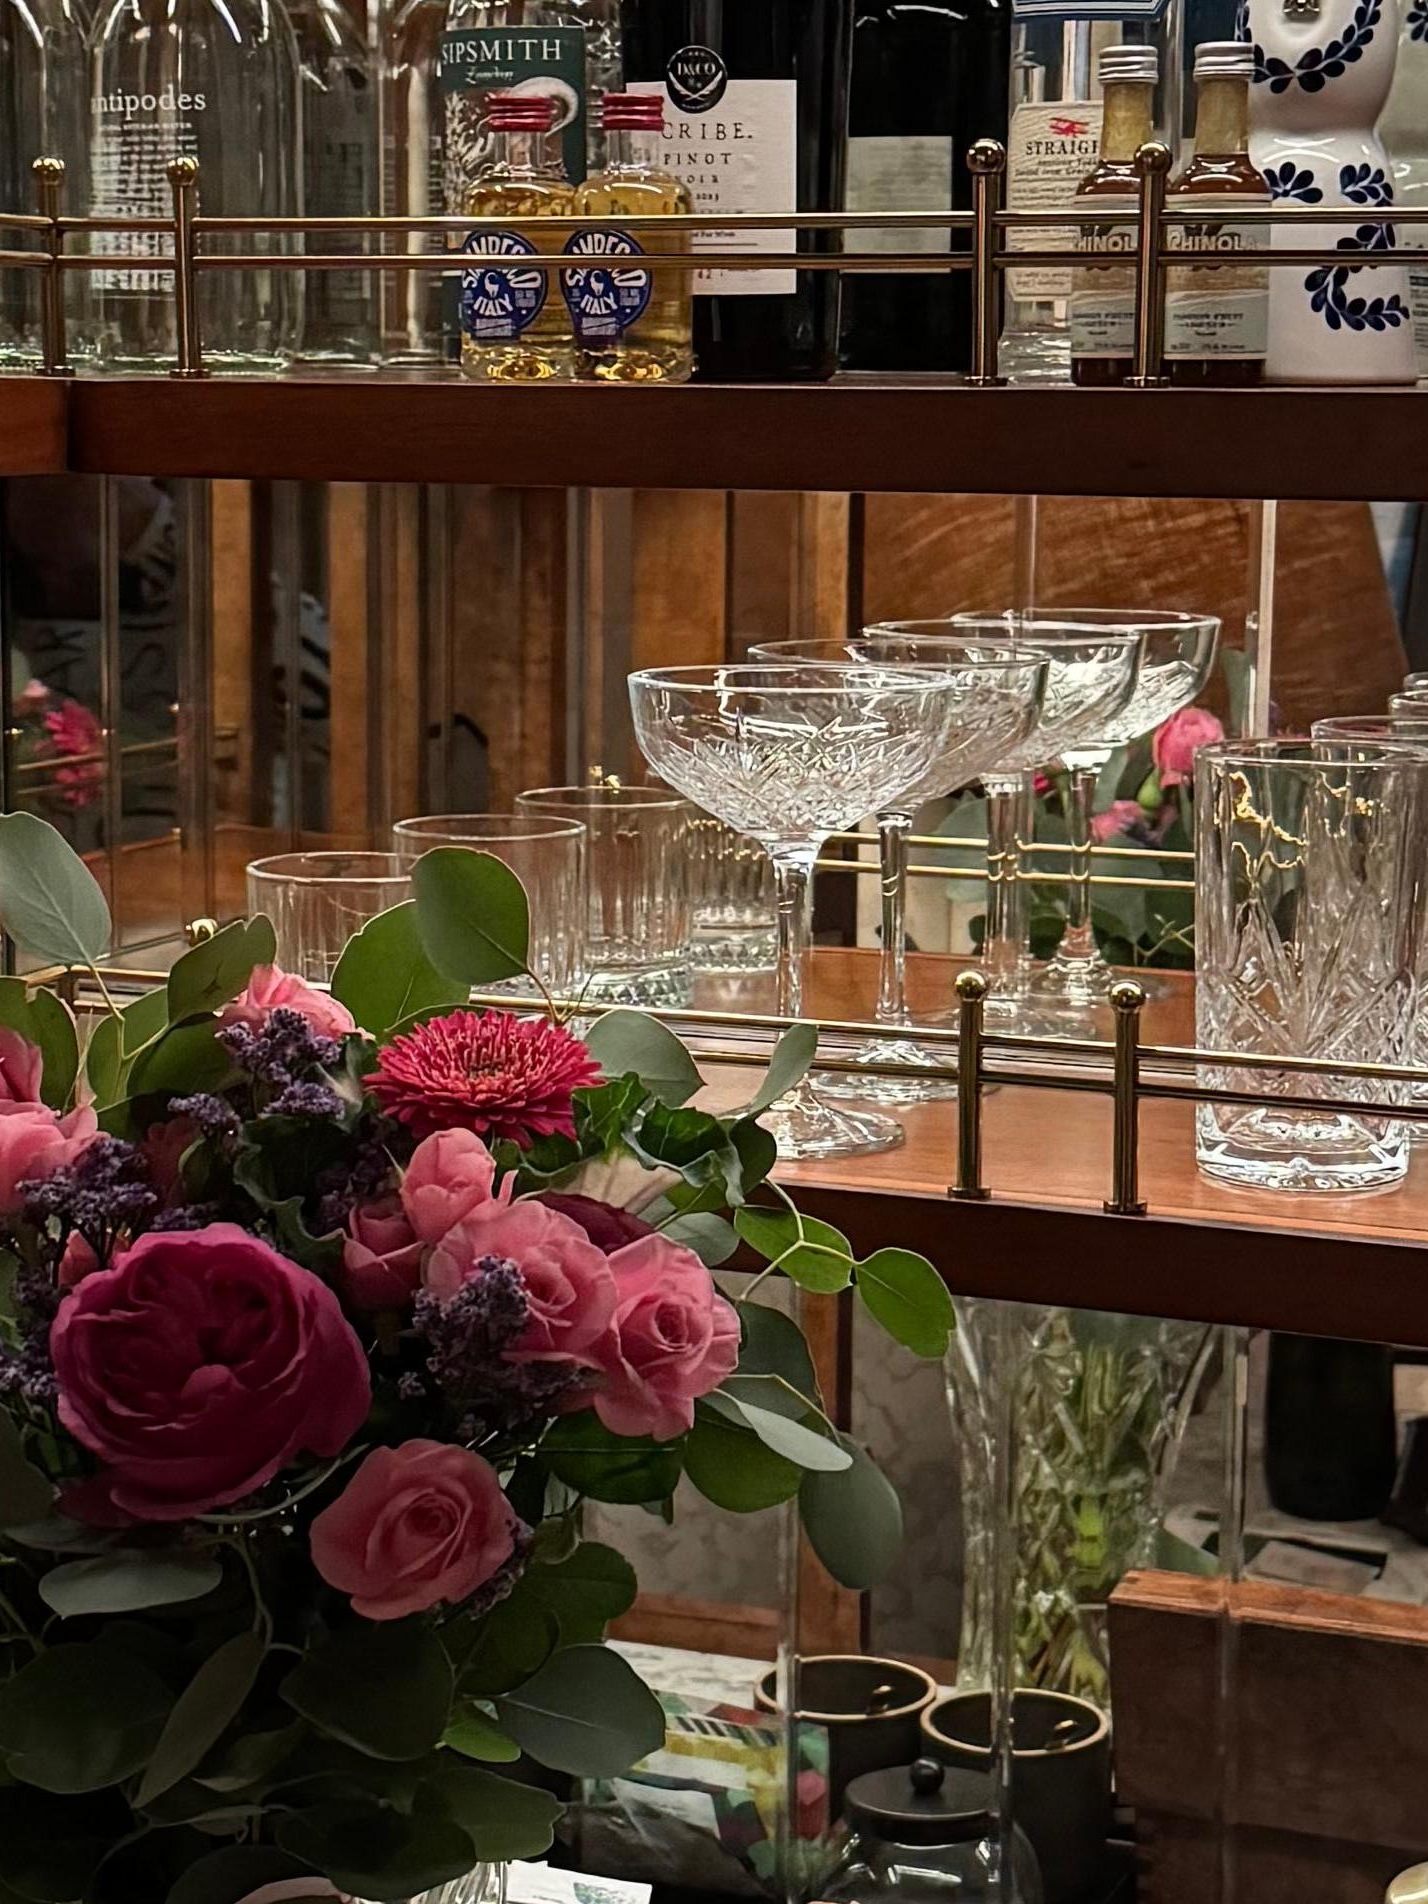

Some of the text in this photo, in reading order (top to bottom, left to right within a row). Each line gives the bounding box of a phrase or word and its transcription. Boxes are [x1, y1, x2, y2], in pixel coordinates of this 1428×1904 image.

[441, 38, 563, 65] SIPSMITH
[663, 152, 732, 165] PINOT
[473, 292, 514, 317] ITALY
[580, 291, 618, 315] ITALY
